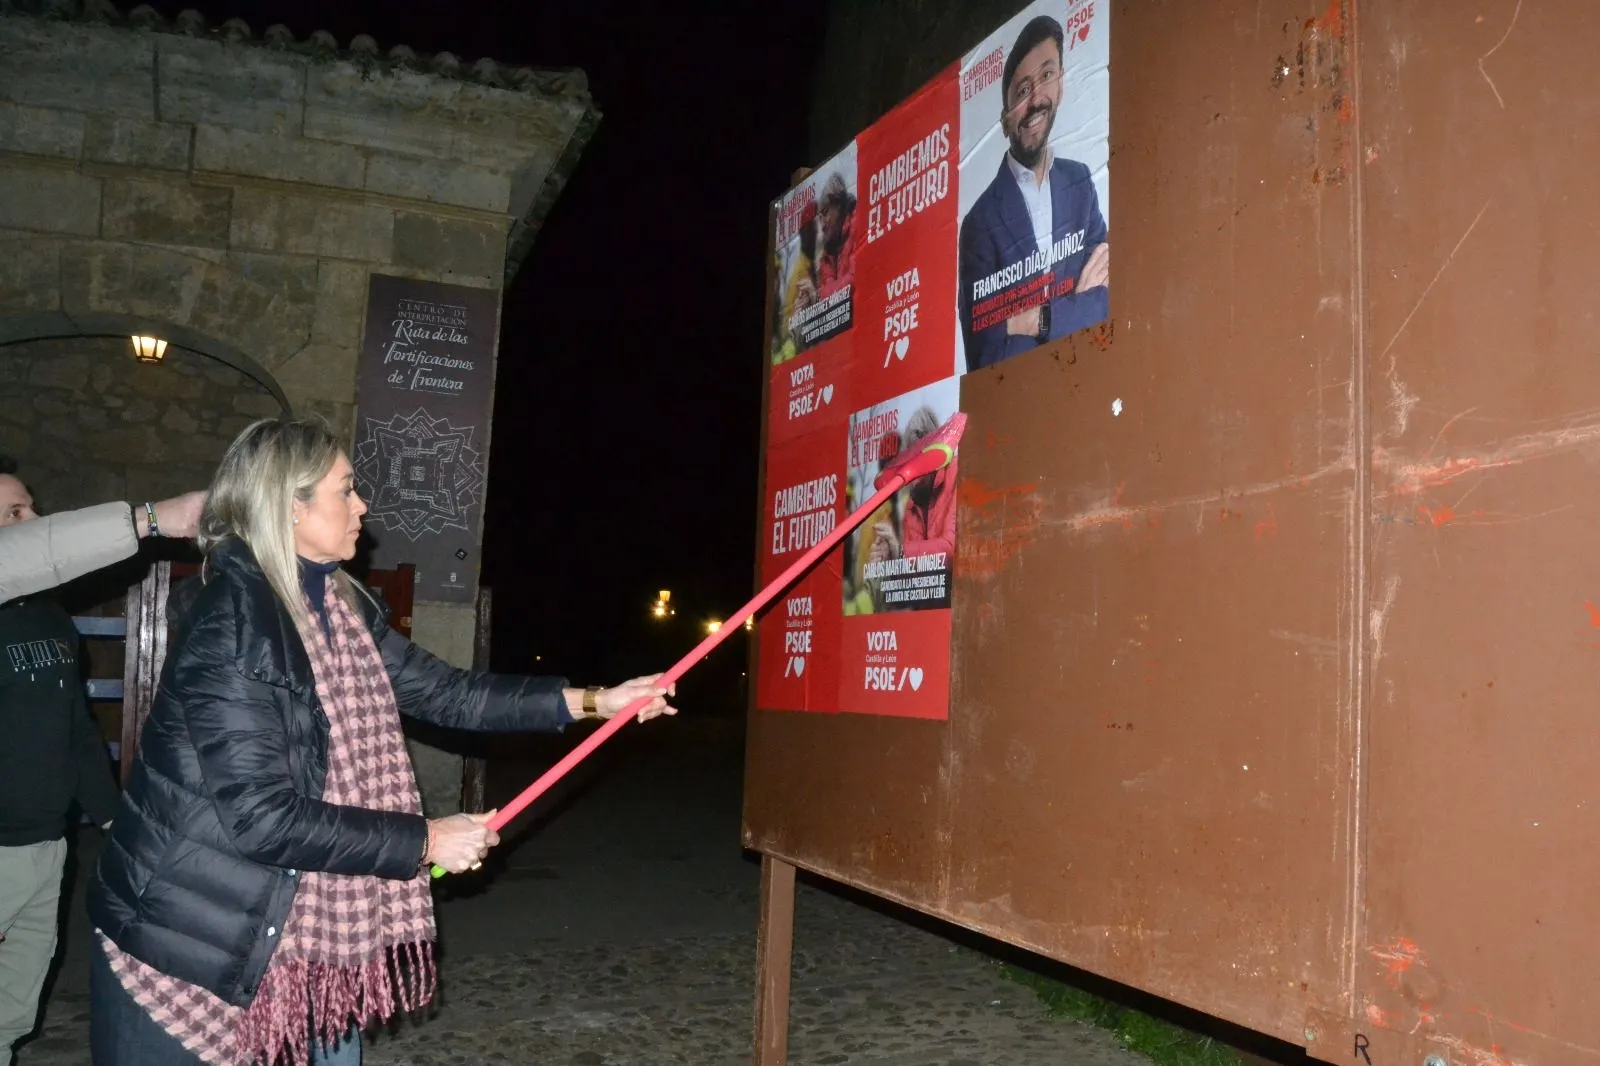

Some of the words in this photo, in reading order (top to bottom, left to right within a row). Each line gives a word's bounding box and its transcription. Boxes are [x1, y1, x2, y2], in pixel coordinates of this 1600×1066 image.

[1066, 2, 1094, 33] PSOE
[963, 46, 1003, 85] CAMBIEMOS
[964, 84, 973, 101] EL
[975, 60, 1003, 94] FUTURO
[869, 123, 950, 206] CAMBIEMOS
[868, 204, 884, 244] EL
[887, 160, 949, 232] FUTURO
[973, 261, 1022, 301] FRANCISCO
[1025, 250, 1049, 277] DÍAZ
[1050, 229, 1085, 264] MUÑOZ
[886, 267, 920, 301] VOTA
[392, 319, 431, 345] Ruta
[431, 327, 448, 341] de
[449, 328, 468, 344] las
[884, 303, 919, 342] PSOE
[383, 341, 474, 371] Fortificaciones
[388, 369, 404, 384] de
[408, 367, 464, 391] Frontera
[790, 363, 814, 387] VOTA
[788, 392, 813, 420] PSOE
[852, 408, 899, 441] CAMBIEMOS
[774, 473, 837, 519] CAMBIEMOS
[772, 521, 786, 555] EL
[788, 508, 836, 552] FUTURO
[863, 561, 885, 579] CARLOS
[917, 551, 946, 573] MÍNGUEZ
[787, 596, 812, 617] VOTA
[7, 639, 61, 667] PUMA
[785, 630, 812, 654] PSOE
[866, 631, 897, 651] VOTA
[864, 666, 896, 691] PSOE
[1354, 1033, 1372, 1066] R
